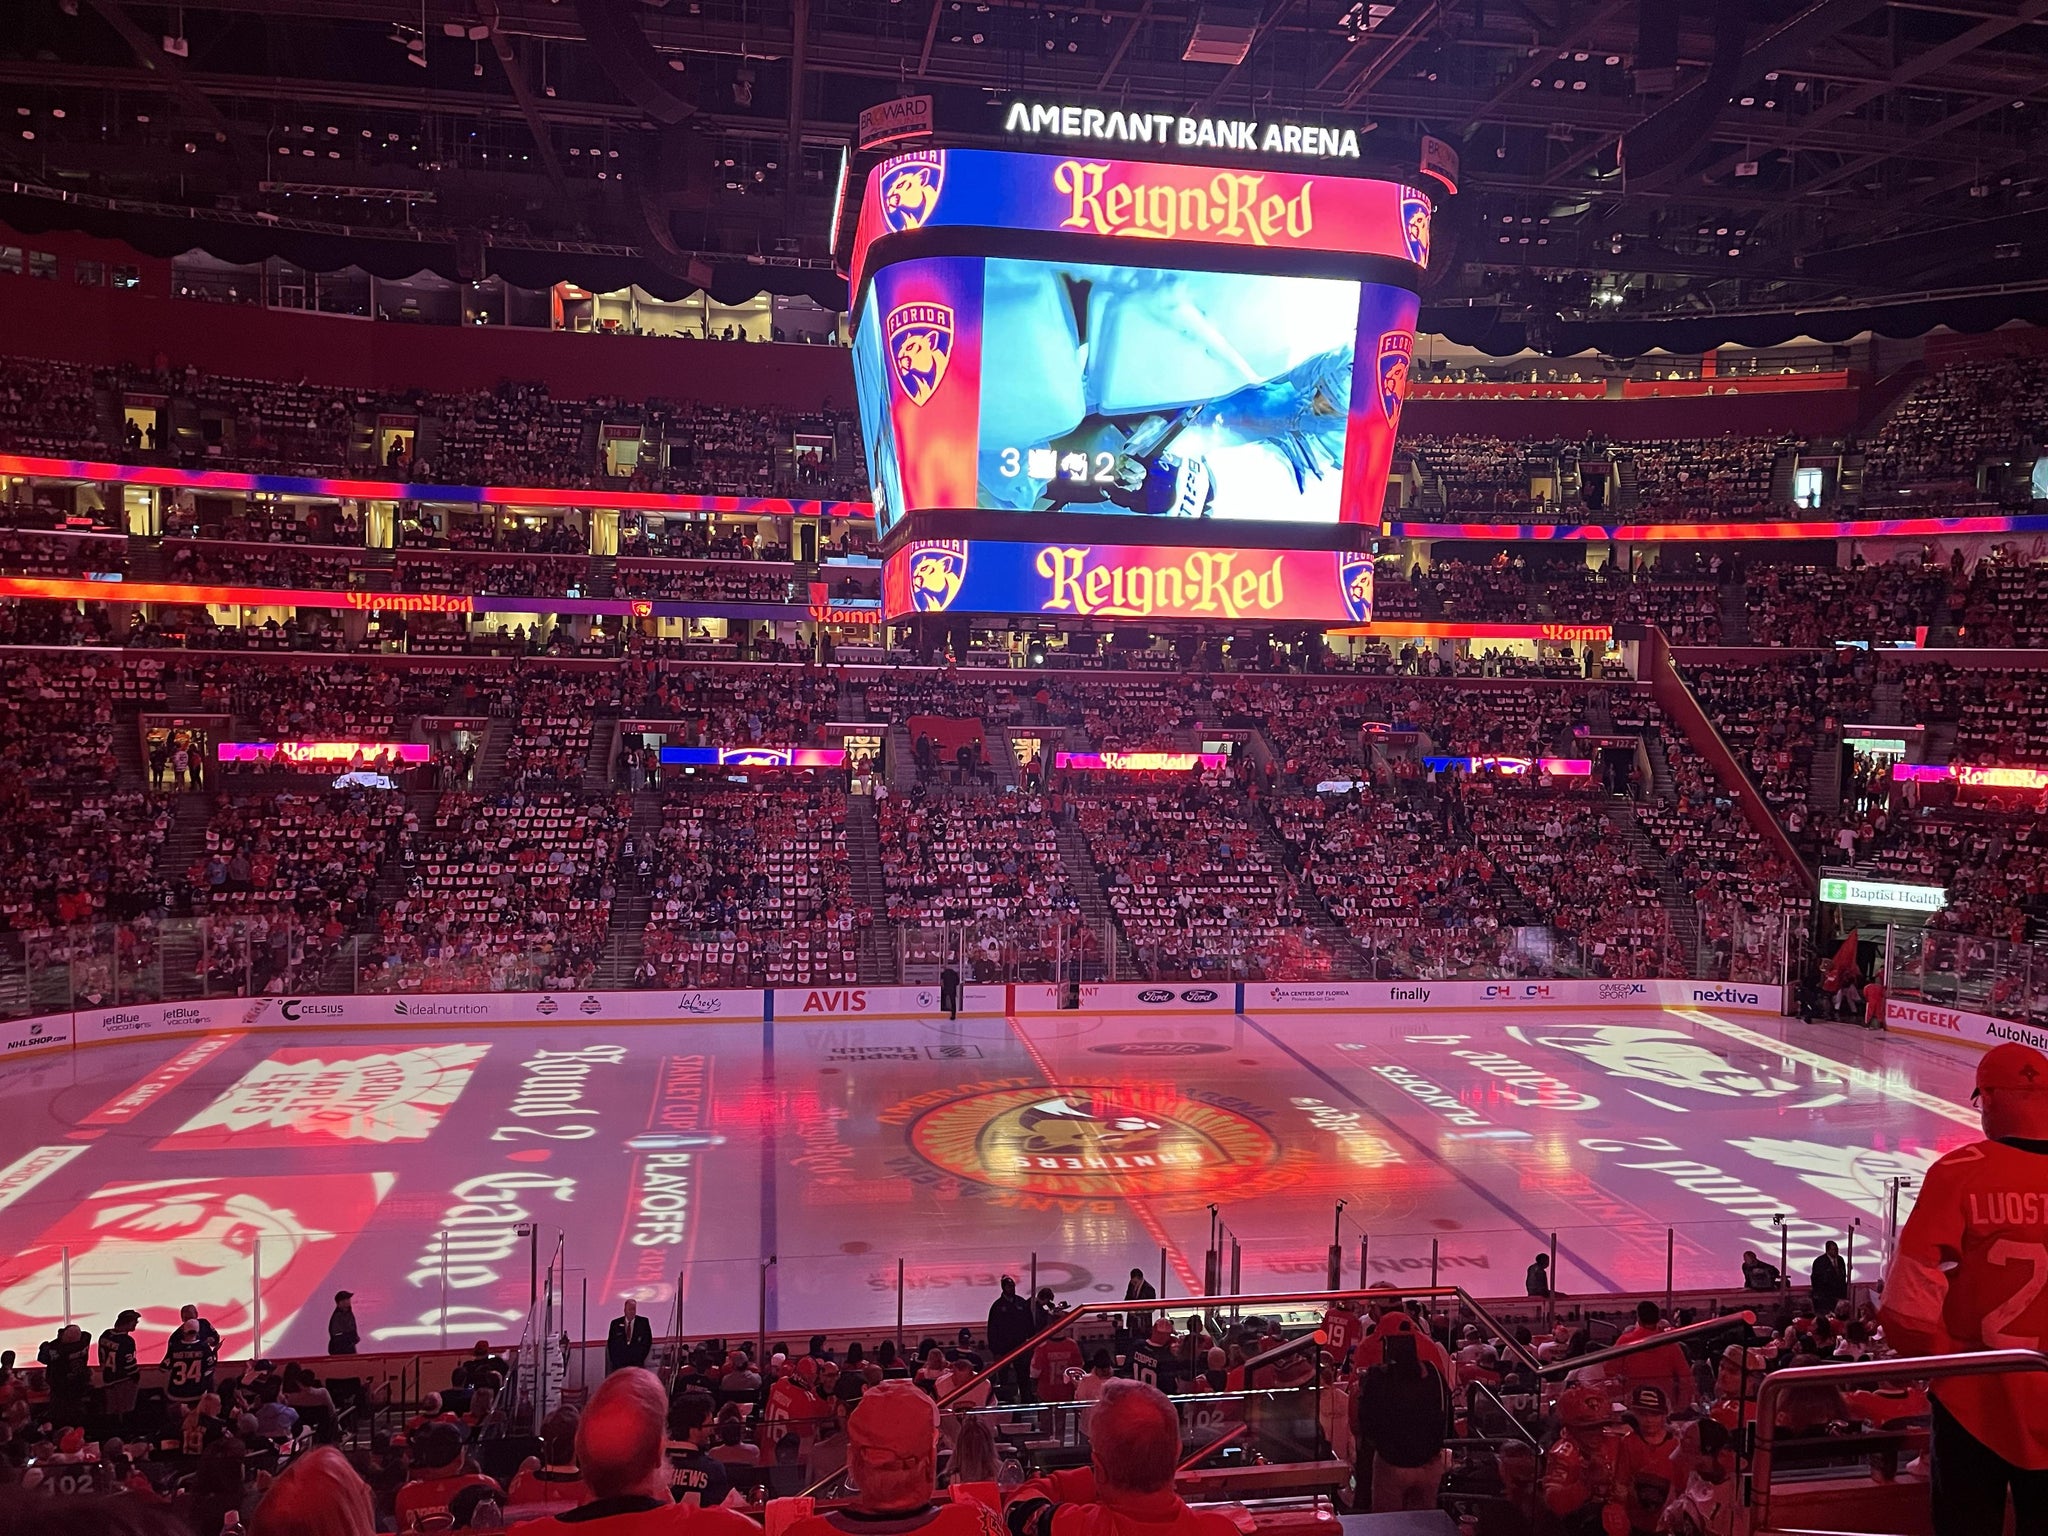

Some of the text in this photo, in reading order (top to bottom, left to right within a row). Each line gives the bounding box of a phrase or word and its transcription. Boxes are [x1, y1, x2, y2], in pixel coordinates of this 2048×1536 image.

[1007, 102, 1361, 158] AMERANT BANK ARENA
[888, 306, 945, 332] FLORIDA
[1001, 447, 1115, 482] 3 2
[1850, 887, 1942, 906] Baptist Health
[803, 991, 867, 1012] AVIS
[1143, 990, 1169, 1002] Ford
[1186, 990, 1212, 1002] Ford
[1390, 987, 1431, 1002] finally
[1693, 989, 1759, 1005] nextiva
[103, 1014, 140, 1028] jetBlue
[163, 1008, 200, 1020] jetBlue
[301, 1005, 344, 1014] CELSIUS
[409, 1004, 488, 1015] idealnutrition
[664, 1054, 705, 1101] STANLEY
[232, 1072, 310, 1114] LEAFS
[280, 1071, 354, 1112] MAPLE
[309, 1061, 405, 1122] TORONTO
[1371, 1065, 1492, 1126] PLAYOFFS
[631, 1153, 691, 1247] PLAYOFFS
[1970, 1191, 2048, 1226] LUOST
[1327, 1323, 1345, 1348] 19
[173, 1360, 202, 1386] 34
[1183, 1410, 1225, 1428] 102
[43, 1475, 94, 1495] 102
